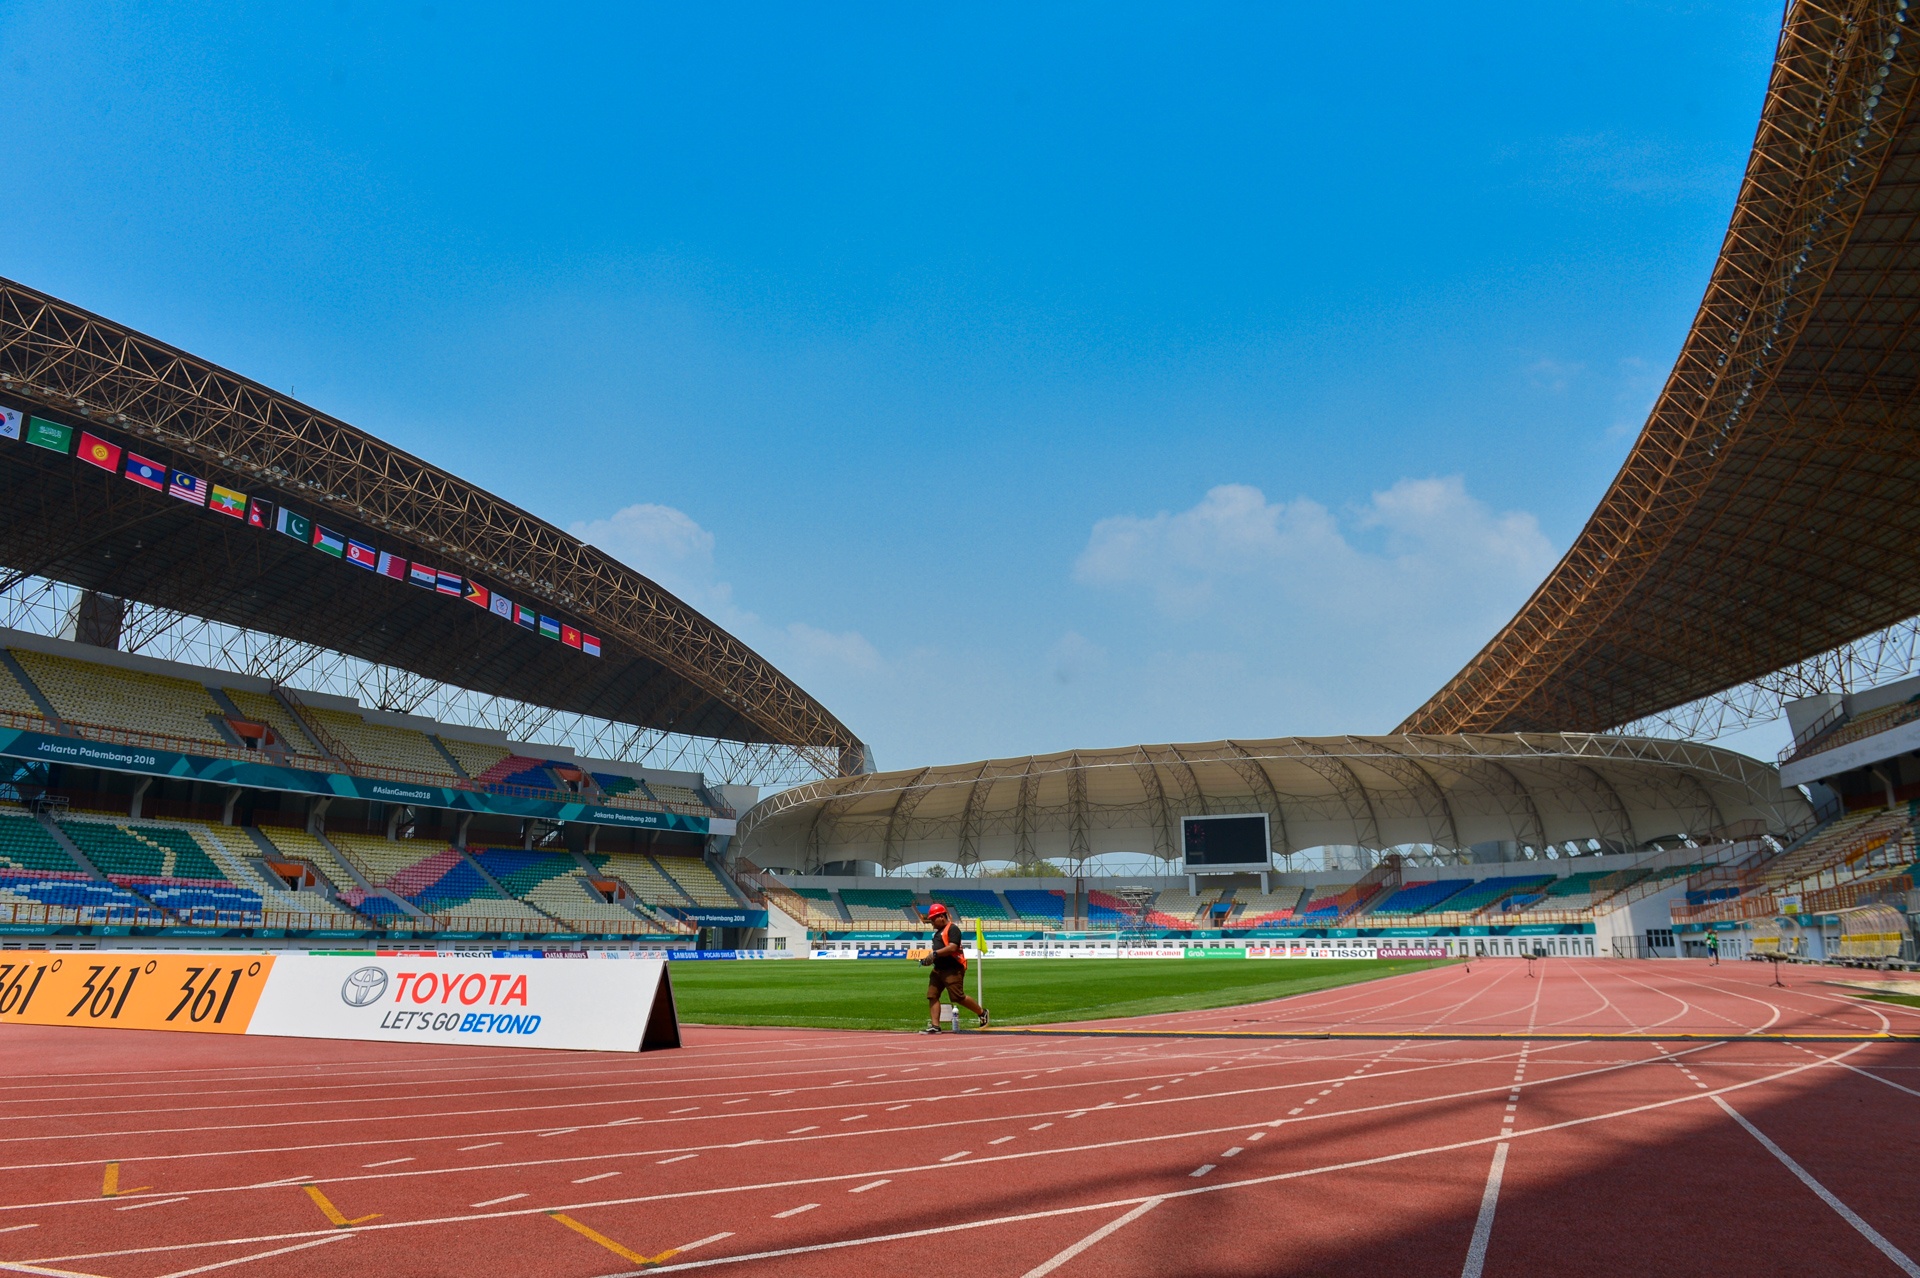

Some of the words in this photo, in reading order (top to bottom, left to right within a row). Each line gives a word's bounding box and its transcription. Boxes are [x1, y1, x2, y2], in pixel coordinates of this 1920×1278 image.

[38, 742, 77, 755] Jakarta
[80, 747, 132, 764] Palembang
[134, 755, 155, 765] 2018
[373, 786, 430, 799] #AsianGames2018
[593, 811, 614, 819] Jakarta
[615, 814, 644, 824] Palembang
[706, 915, 733, 923] Palembang
[1188, 949, 1205, 957] Grab
[1380, 949, 1407, 957] QATAR
[1408, 949, 1442, 957] AIRWAYS
[395, 972, 527, 1006] TOYOTA
[380, 1011, 434, 1030] LET'S
[432, 1013, 460, 1031] GO
[459, 1013, 541, 1034] BEYOND
